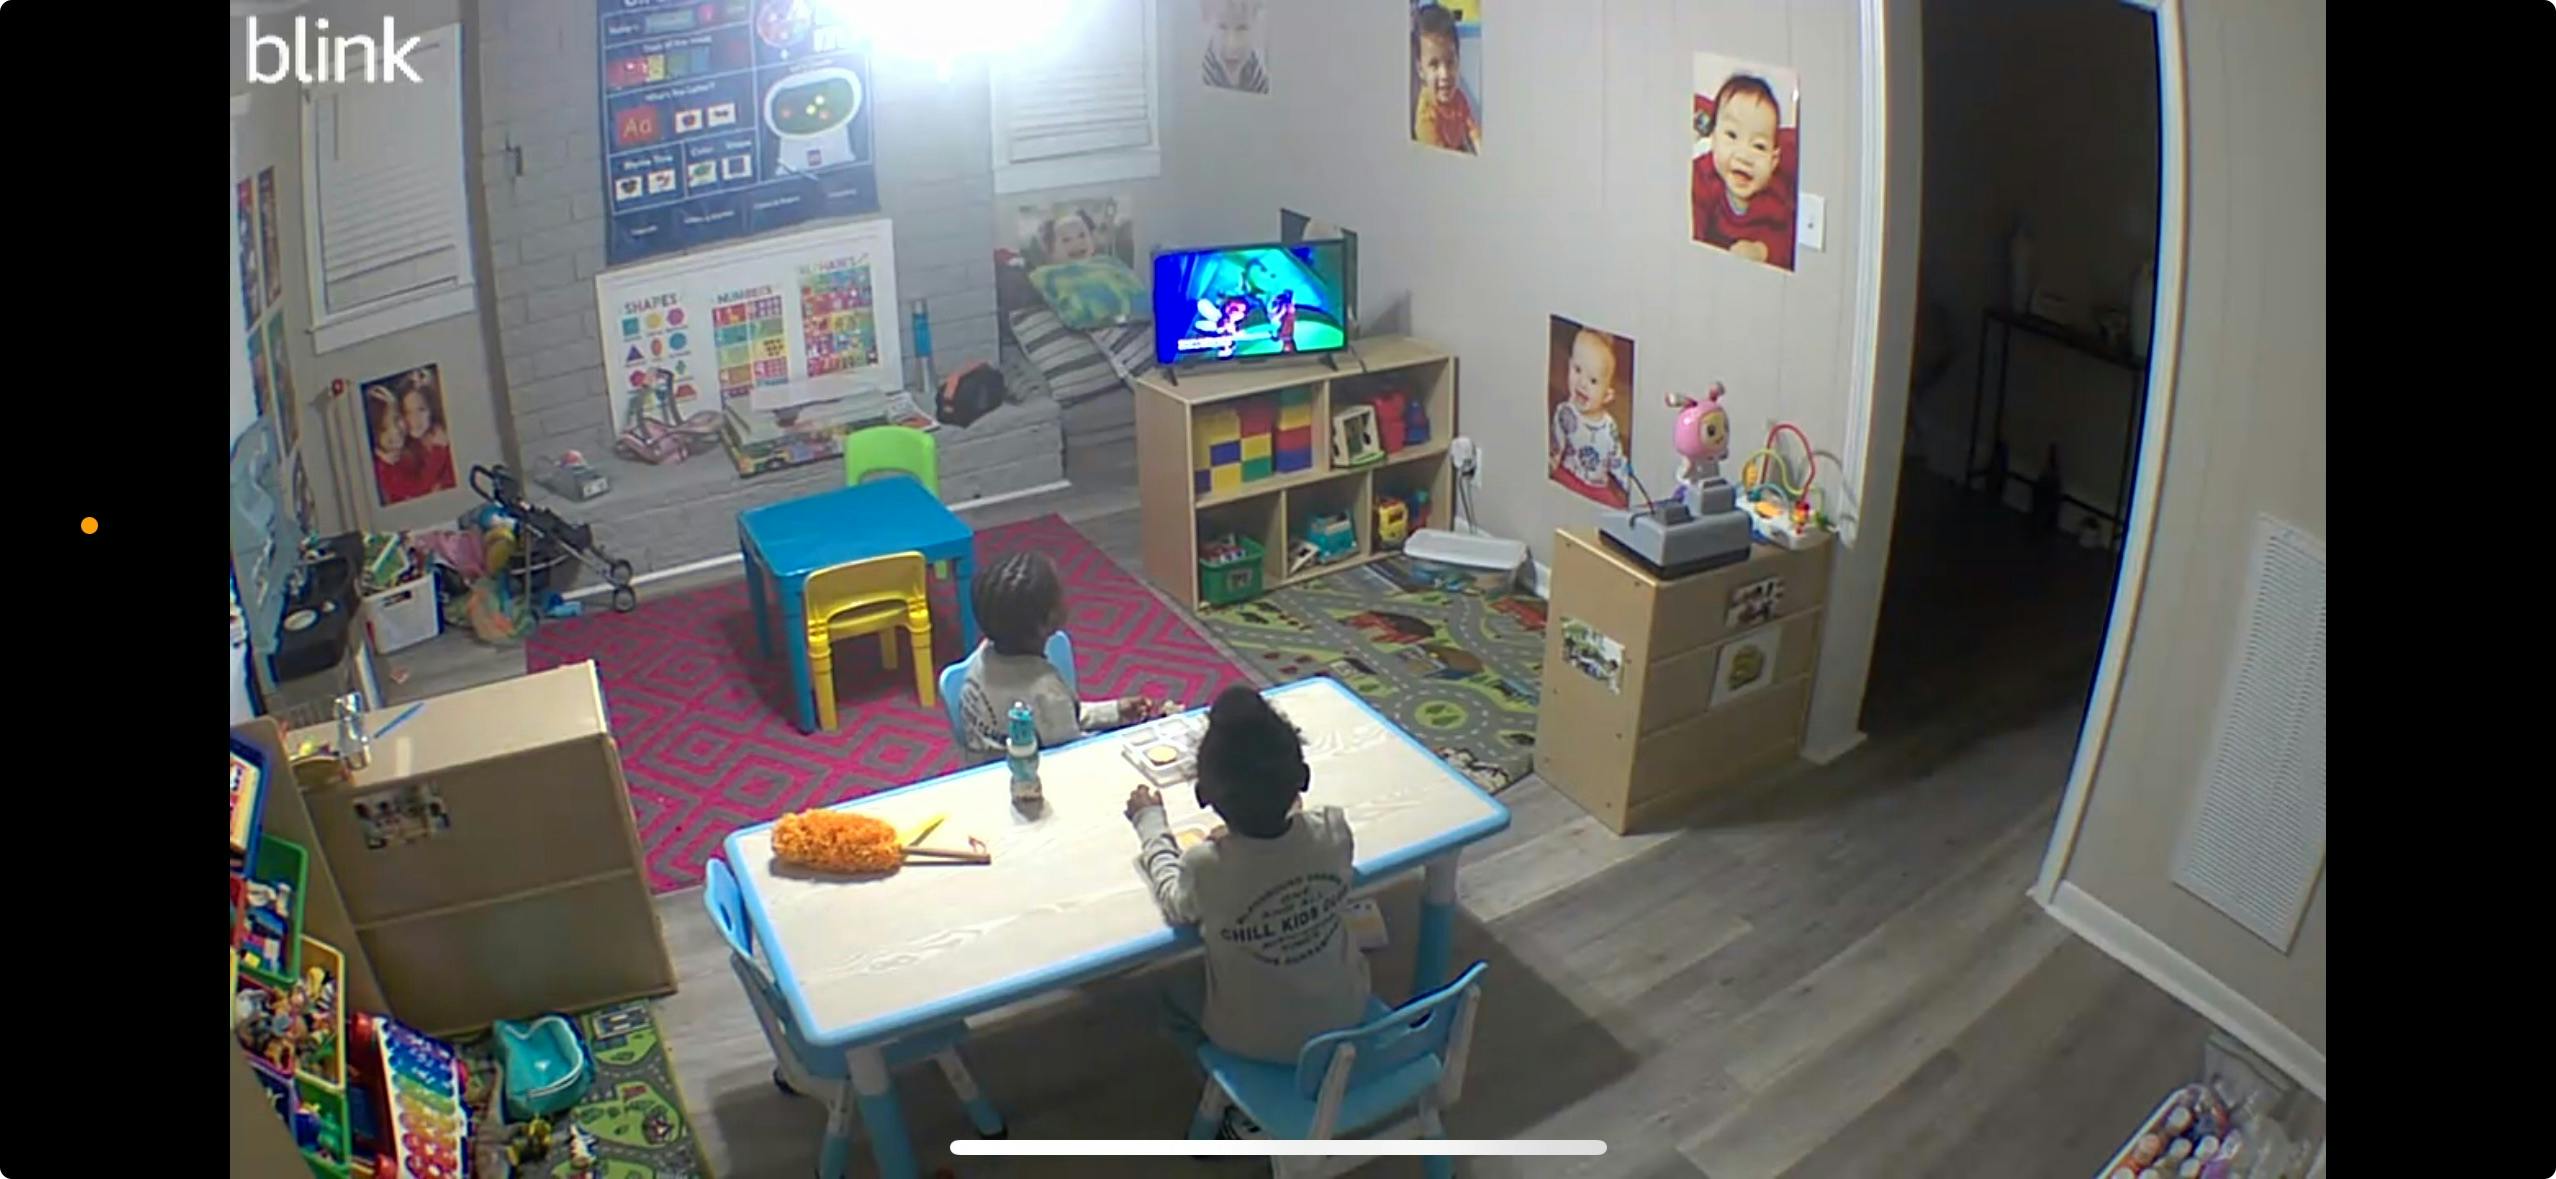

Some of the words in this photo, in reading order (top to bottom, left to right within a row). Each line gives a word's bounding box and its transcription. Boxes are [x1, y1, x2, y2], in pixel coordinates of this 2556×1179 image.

[623, 117, 652, 138] Aa
[623, 292, 677, 314] SHAPES
[1220, 922, 1277, 943] CHILL
[1281, 905, 1319, 933] KIDS
